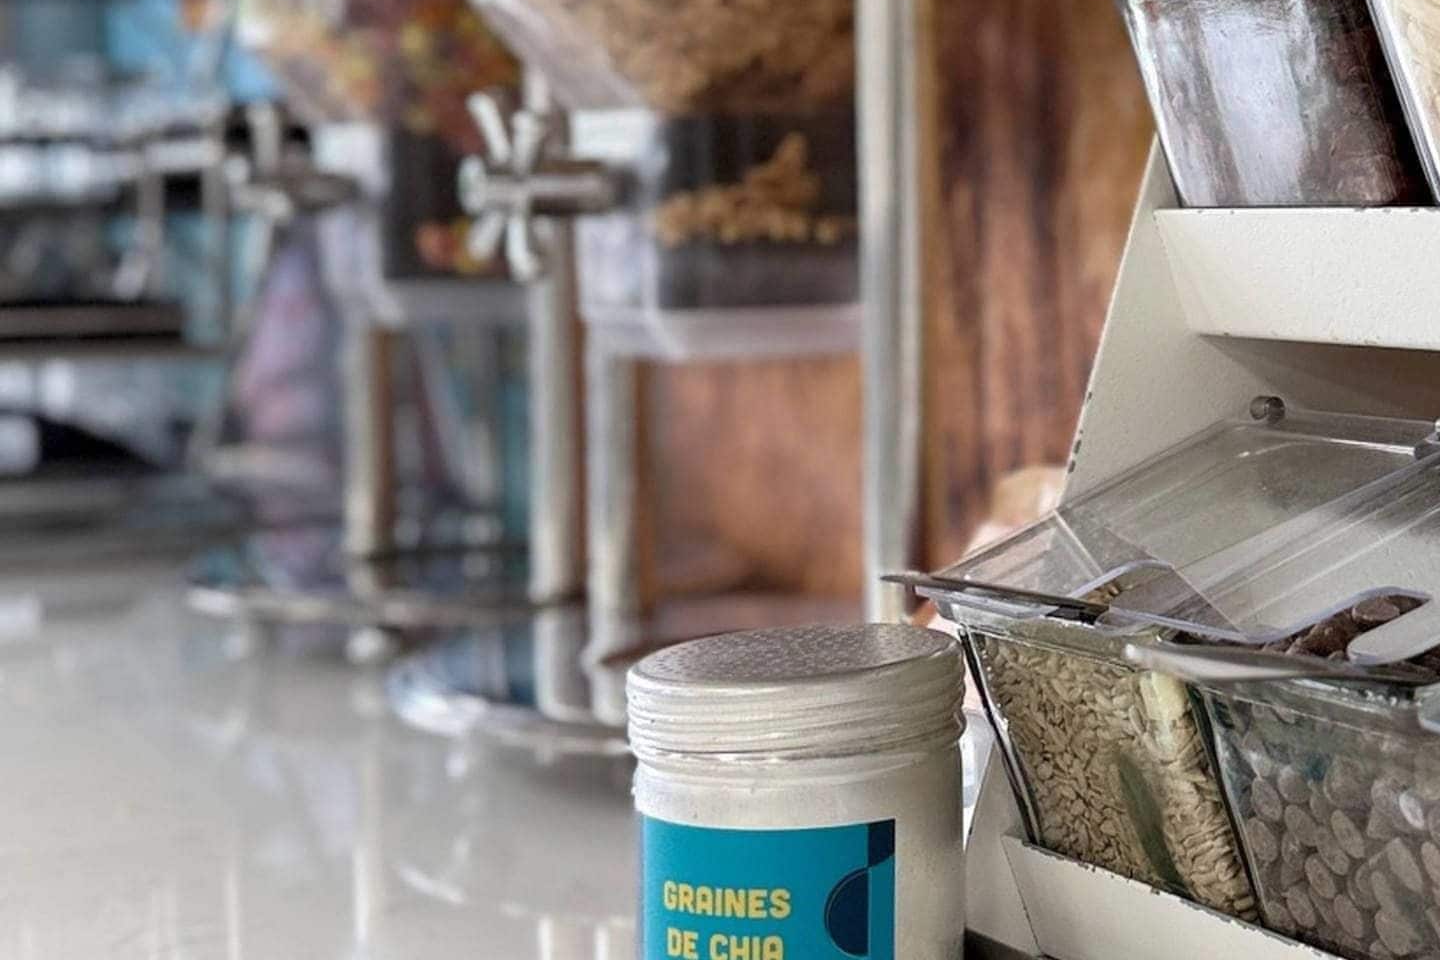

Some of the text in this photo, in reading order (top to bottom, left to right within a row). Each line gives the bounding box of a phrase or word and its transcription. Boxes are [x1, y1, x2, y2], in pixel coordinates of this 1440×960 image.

[663, 880, 791, 919] GRAINES
[667, 927, 784, 960] DE CHIA
